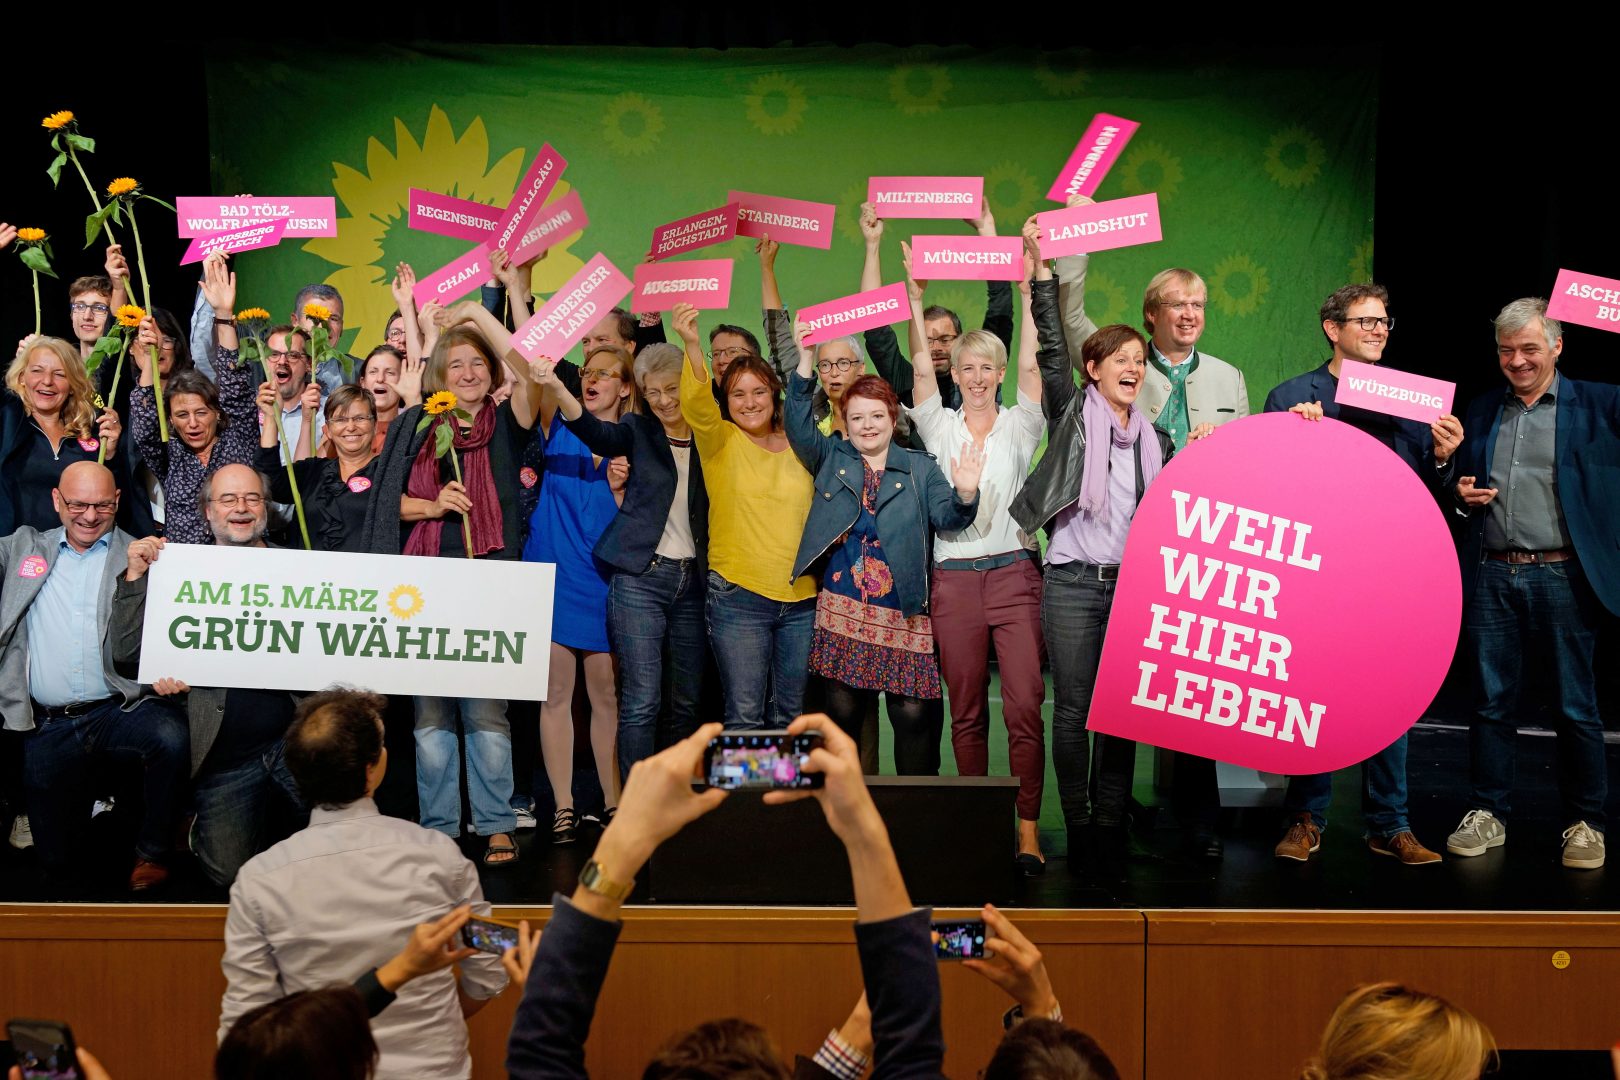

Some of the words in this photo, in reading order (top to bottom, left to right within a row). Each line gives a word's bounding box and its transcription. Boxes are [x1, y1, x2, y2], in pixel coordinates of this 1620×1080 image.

[220, 205, 249, 217] BAD
[252, 203, 295, 217] TÖLZ-
[498, 158, 554, 249] OBERALLGÄU
[876, 191, 973, 204] MILTENBERG
[187, 218, 328, 230] WOLFRATAUSEN
[516, 209, 573, 251] REISING
[661, 213, 727, 241] ERLANGEN-
[737, 208, 820, 232] STARNBERG
[1048, 213, 1149, 241] LANDSHUT
[198, 225, 276, 248] LANDSBERG
[201, 243, 226, 255] AM
[226, 235, 263, 249] LECH
[657, 224, 728, 254] HÖCHSTADT
[923, 249, 1012, 265] MÜNCHEN
[437, 262, 481, 294] CHAM
[641, 277, 719, 295] AUGSBURG
[1565, 282, 1620, 306] ASCH
[521, 265, 611, 351] NÜRNBERGER
[558, 301, 597, 339] LAND
[809, 298, 899, 331] NÜRNBERG
[1348, 376, 1443, 410] WÜRZBURG
[1171, 489, 1322, 572] WEIL
[174, 580, 233, 606] AM
[240, 583, 274, 608] 15.
[281, 582, 379, 613] MÄRZ
[1160, 546, 1281, 620] WIR
[168, 611, 304, 654] GRÜN
[316, 616, 527, 665] WÄHLEN
[1143, 603, 1293, 682] HIER
[1131, 660, 1327, 749] LEBEN
